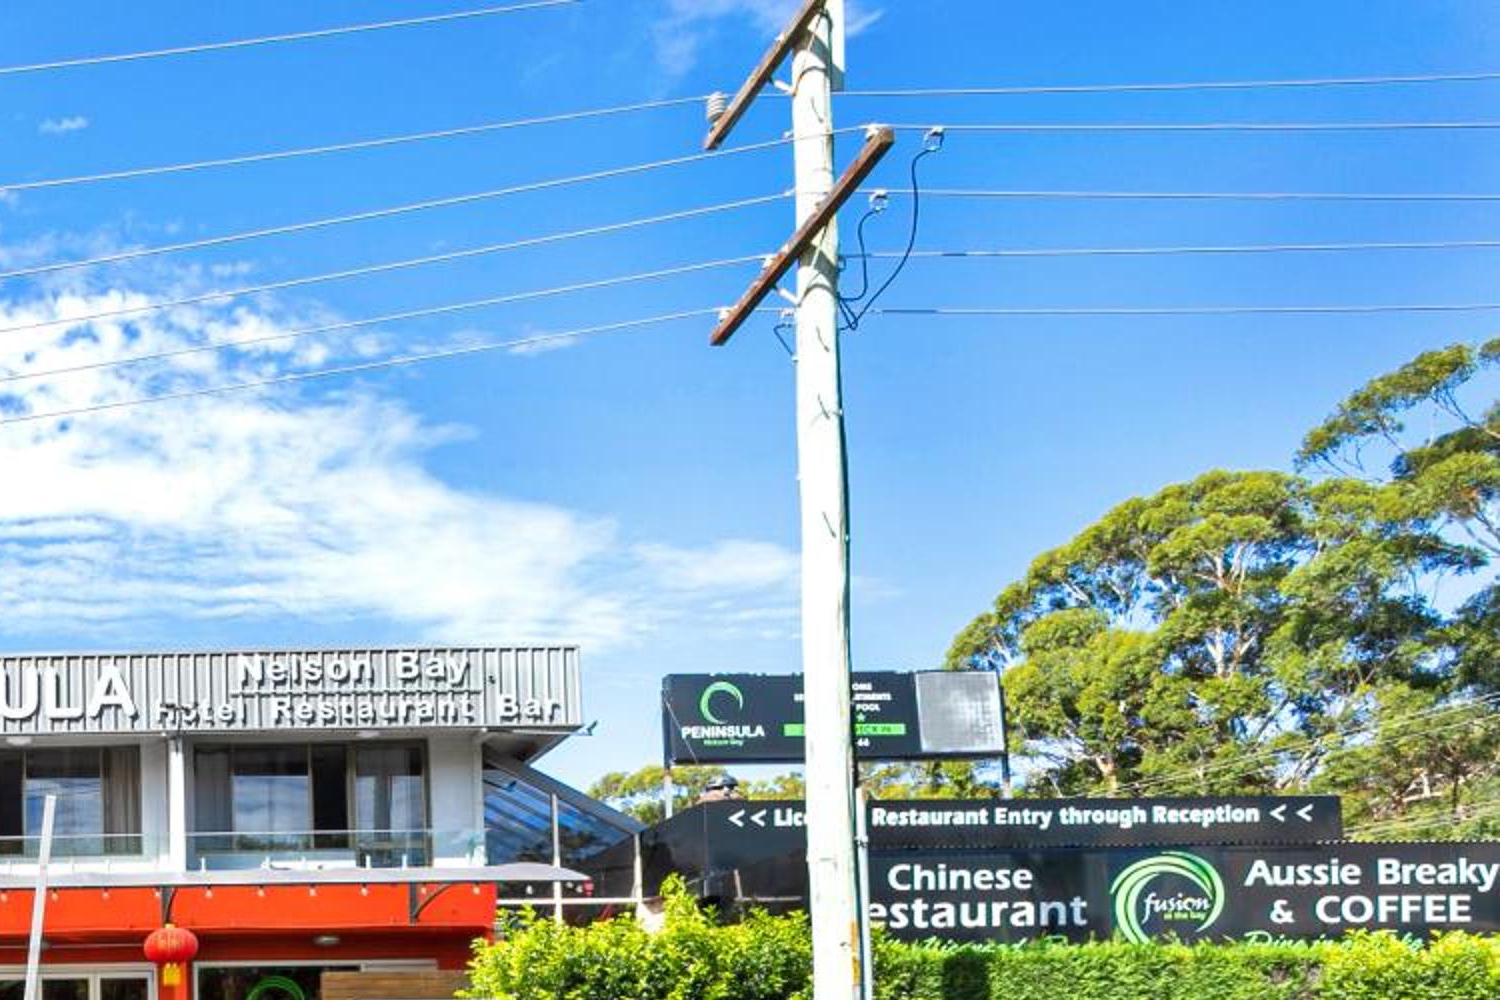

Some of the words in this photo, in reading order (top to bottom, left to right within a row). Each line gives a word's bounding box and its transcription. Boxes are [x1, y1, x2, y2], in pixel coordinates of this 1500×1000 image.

[237, 652, 373, 686] Nelson
[396, 651, 470, 687] Bay
[156, 699, 246, 725] Hotel
[273, 694, 474, 724] Restaurant
[500, 693, 561, 721] Bar
[681, 725, 765, 739] PENINSULA
[872, 807, 988, 827] Restaurant
[995, 807, 1051, 830] Entry
[1060, 806, 1147, 829] through
[1152, 804, 1260, 828] Reception
[887, 863, 1033, 890] Chinese
[1244, 858, 1361, 887] Aussie
[1377, 857, 1500, 893] Breaky
[869, 896, 1087, 928] estaurant
[1142, 892, 1210, 924] fusion
[1270, 899, 1295, 923] &
[1316, 894, 1472, 923] COFFEE
